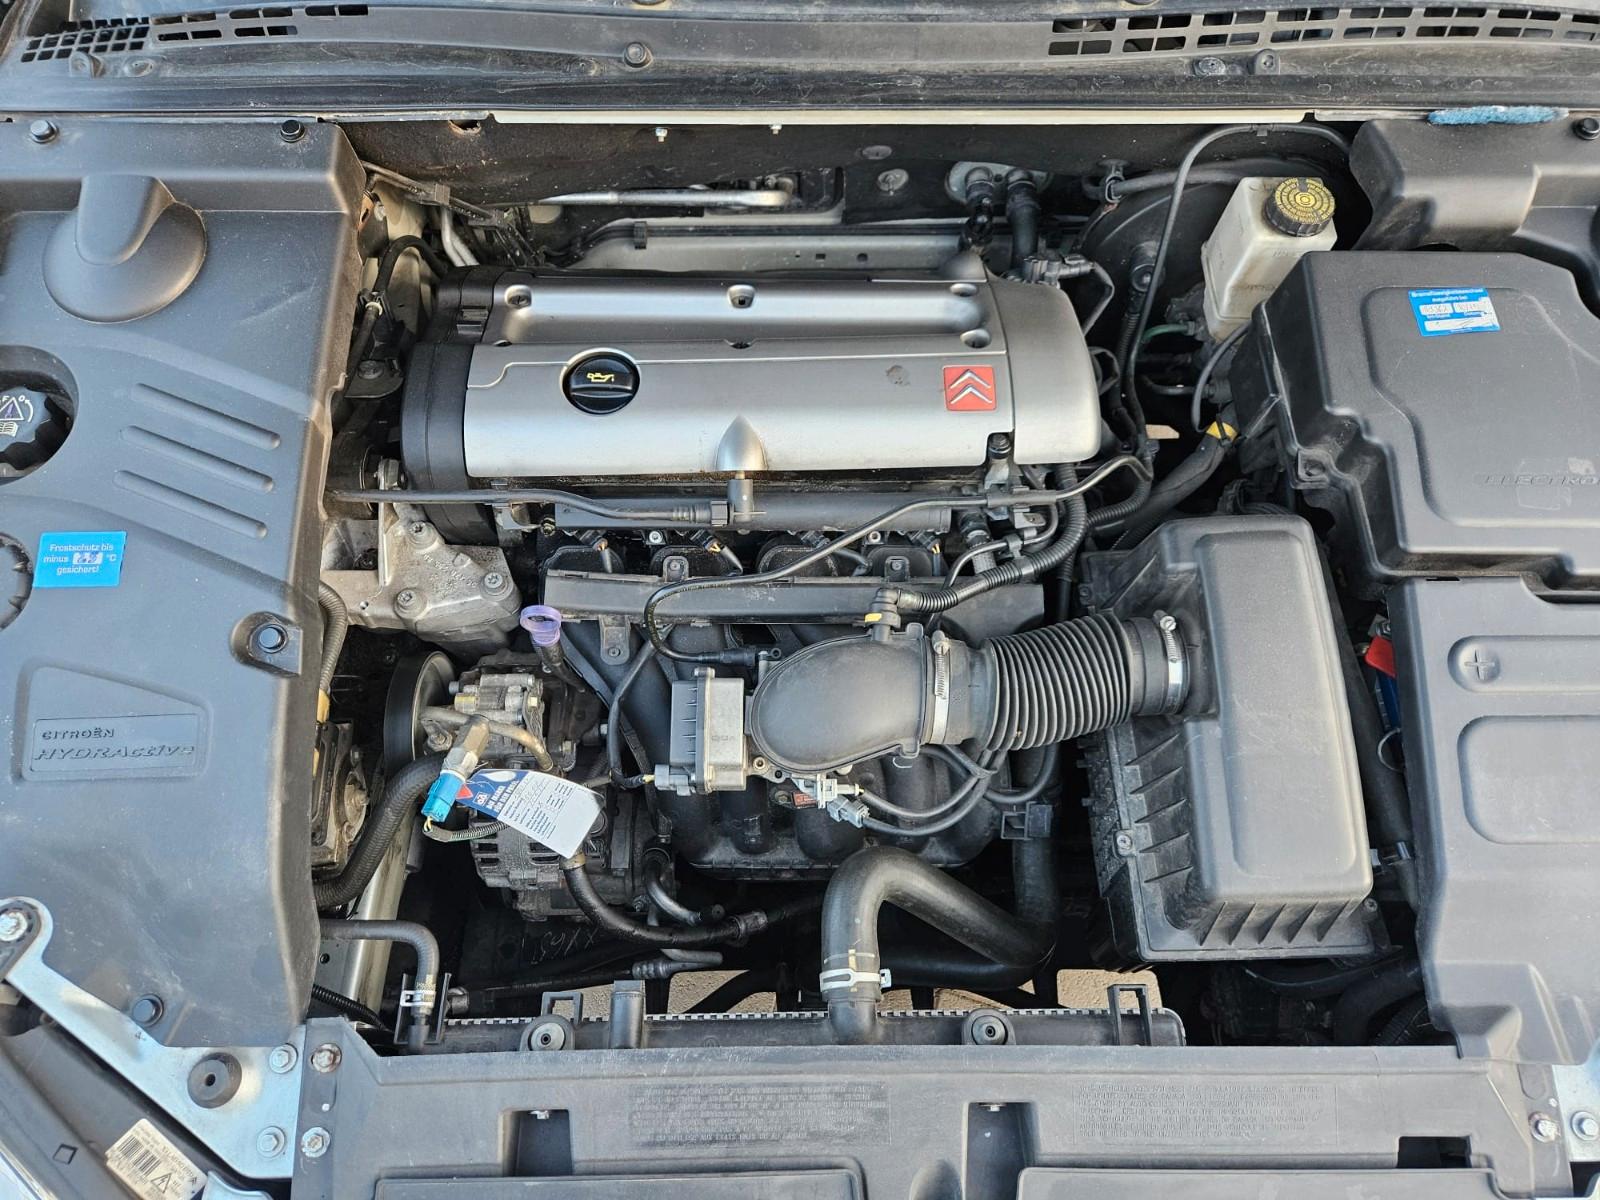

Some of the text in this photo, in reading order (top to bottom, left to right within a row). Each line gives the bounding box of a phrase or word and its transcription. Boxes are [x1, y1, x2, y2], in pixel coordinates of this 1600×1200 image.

[49, 543, 114, 552] Frostschutz bis
[43, 554, 69, 563] minus
[41, 727, 115, 741] CITROËN
